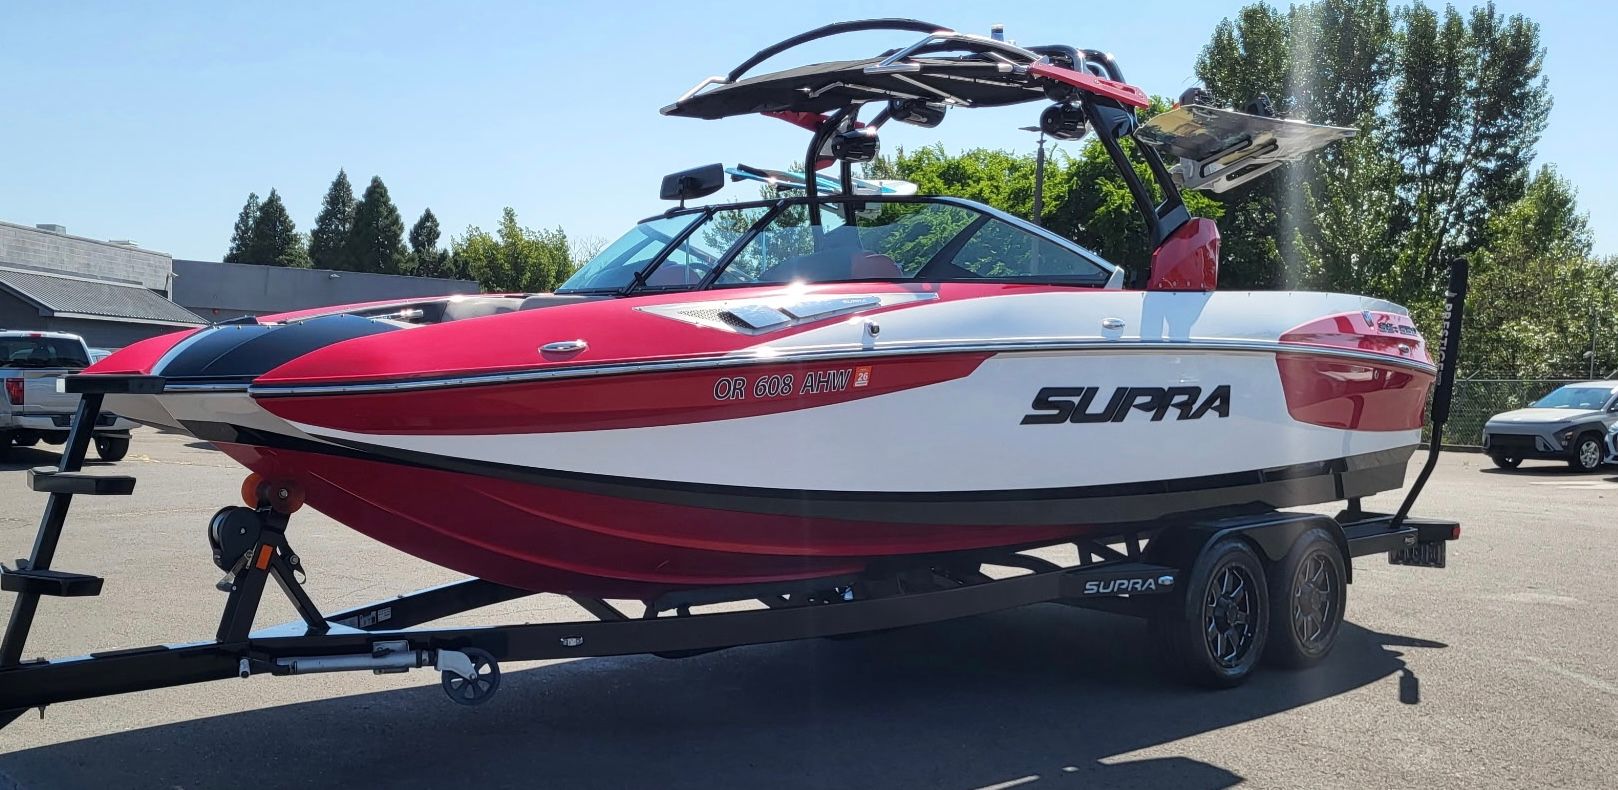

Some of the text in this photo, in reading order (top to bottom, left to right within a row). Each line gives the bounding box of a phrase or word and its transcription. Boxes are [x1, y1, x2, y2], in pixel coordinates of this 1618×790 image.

[713, 368, 852, 401] OR 608 AHW
[857, 372, 869, 381] 26
[1019, 385, 1231, 425] SUPRA
[1083, 578, 1156, 594] SUPRA
